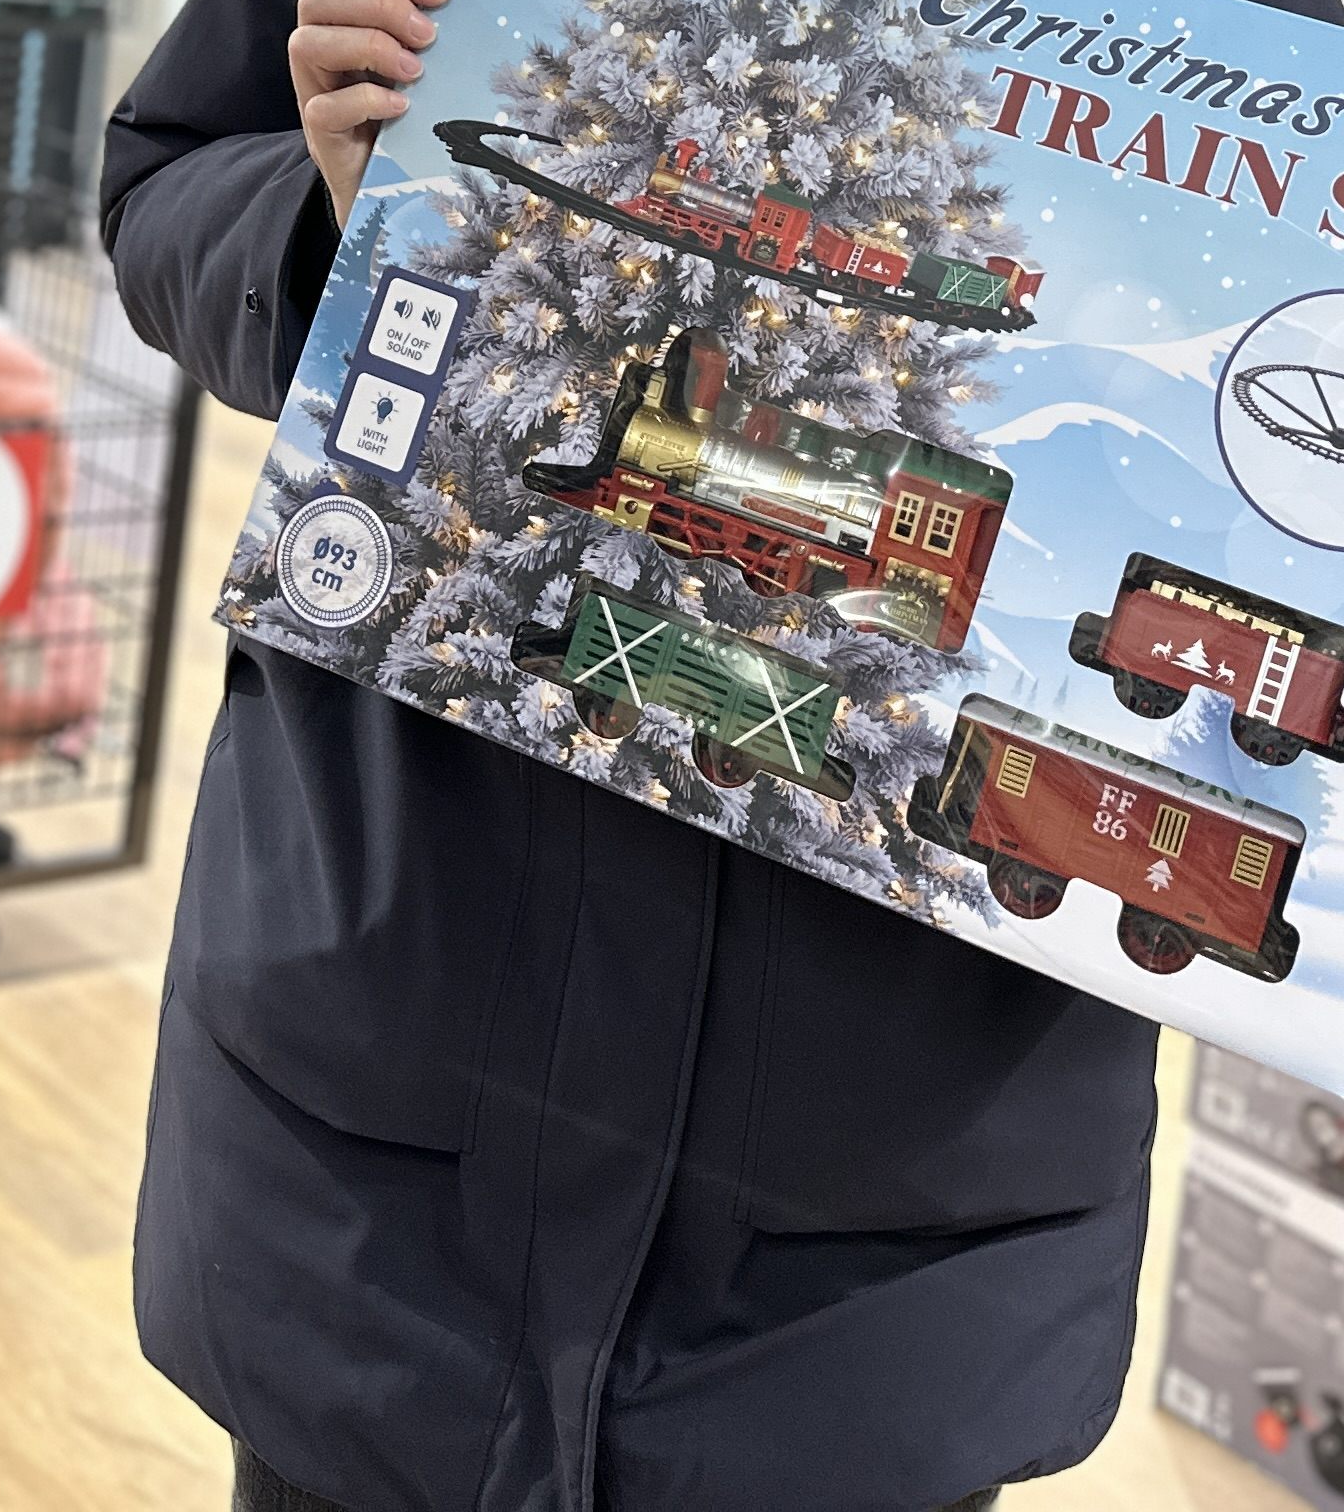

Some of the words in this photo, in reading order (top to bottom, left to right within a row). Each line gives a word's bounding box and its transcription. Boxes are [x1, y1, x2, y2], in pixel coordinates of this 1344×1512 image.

[986, 66, 1307, 218] TRAIN
[386, 341, 423, 361] SOUND
[387, 328, 404, 341] ON
[411, 337, 431, 351] OFF
[356, 437, 386, 456] LIGHT
[362, 426, 389, 444] WITH
[312, 536, 358, 571] Ø93
[311, 567, 343, 592] cm
[1099, 783, 1138, 815] FF
[1092, 810, 1127, 841] 86
